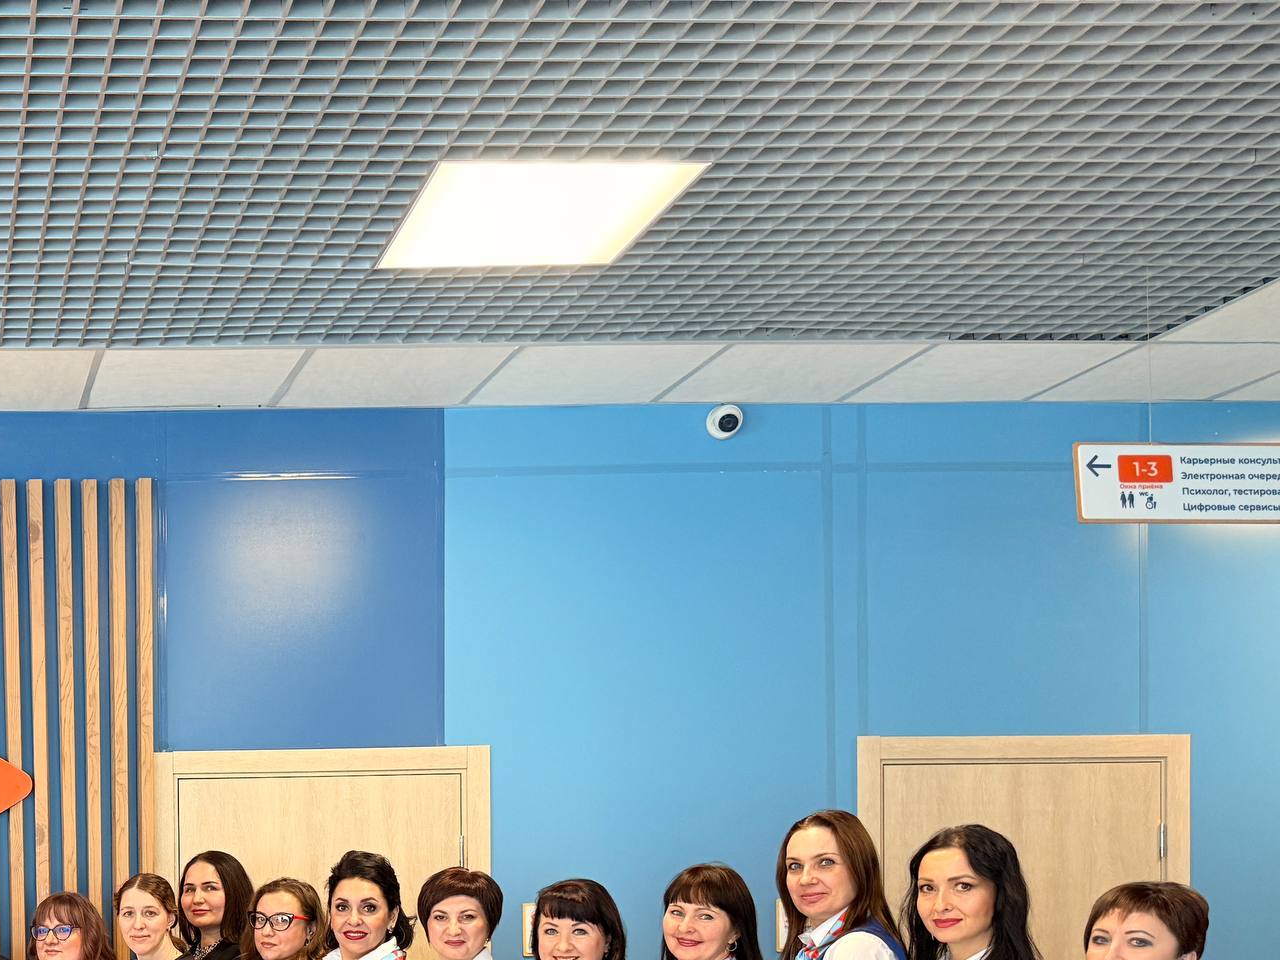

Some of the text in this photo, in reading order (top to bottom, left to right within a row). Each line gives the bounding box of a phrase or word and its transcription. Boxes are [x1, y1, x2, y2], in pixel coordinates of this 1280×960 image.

[1179, 456, 1236, 466] Карьерные
[1132, 461, 1159, 477] 1-3
[1181, 471, 1246, 481] Электронная
[1182, 487, 1231, 497] Психолог,
[1183, 502, 1236, 512] Цифровые
